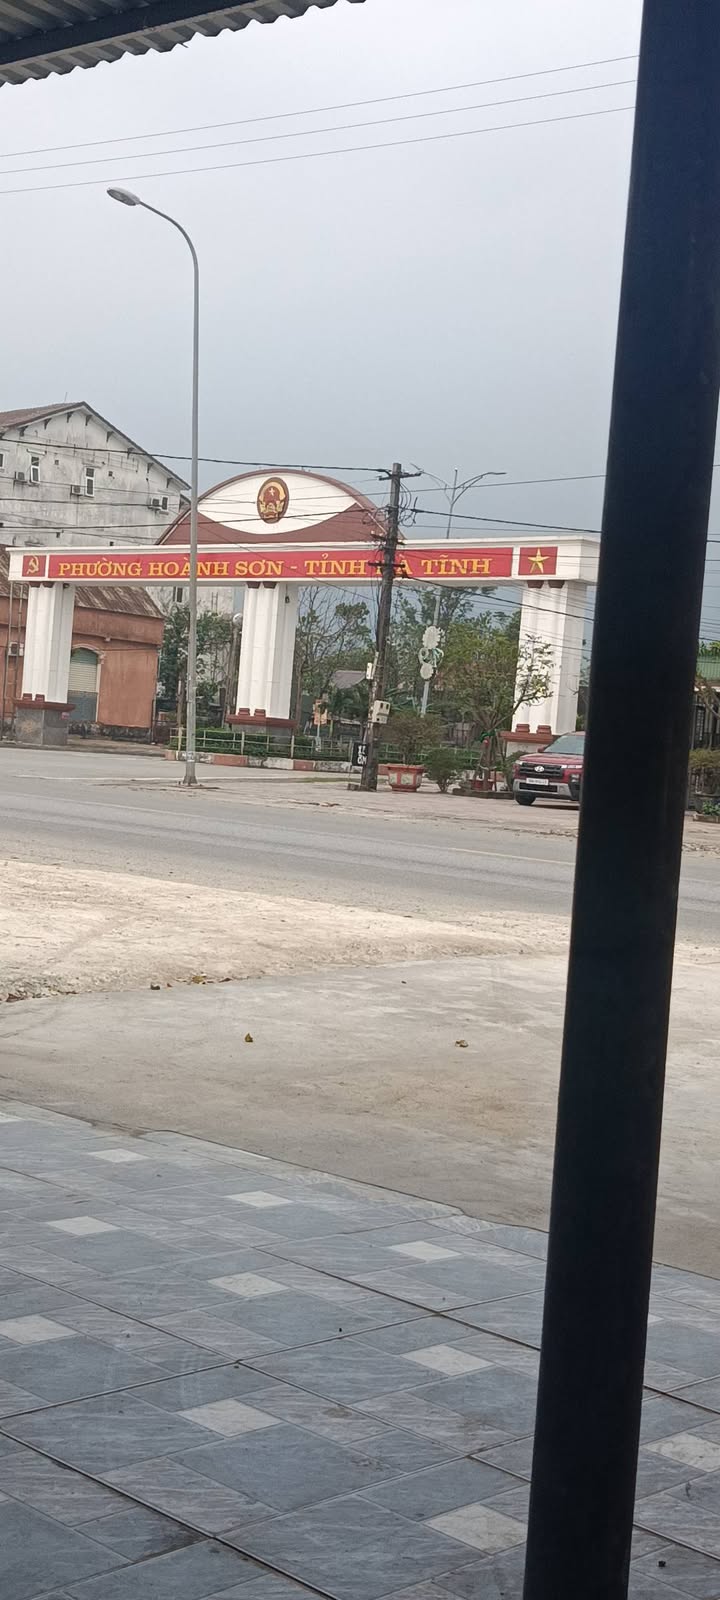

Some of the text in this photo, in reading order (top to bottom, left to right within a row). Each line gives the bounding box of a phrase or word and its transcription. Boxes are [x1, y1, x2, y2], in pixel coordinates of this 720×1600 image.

[58, 557, 142, 577] PHƯỜNG
[149, 556, 229, 576] HOÀNH
[235, 559, 284, 576] SƠN
[304, 552, 367, 576] TỈNH
[421, 553, 492, 575] TĨNH
